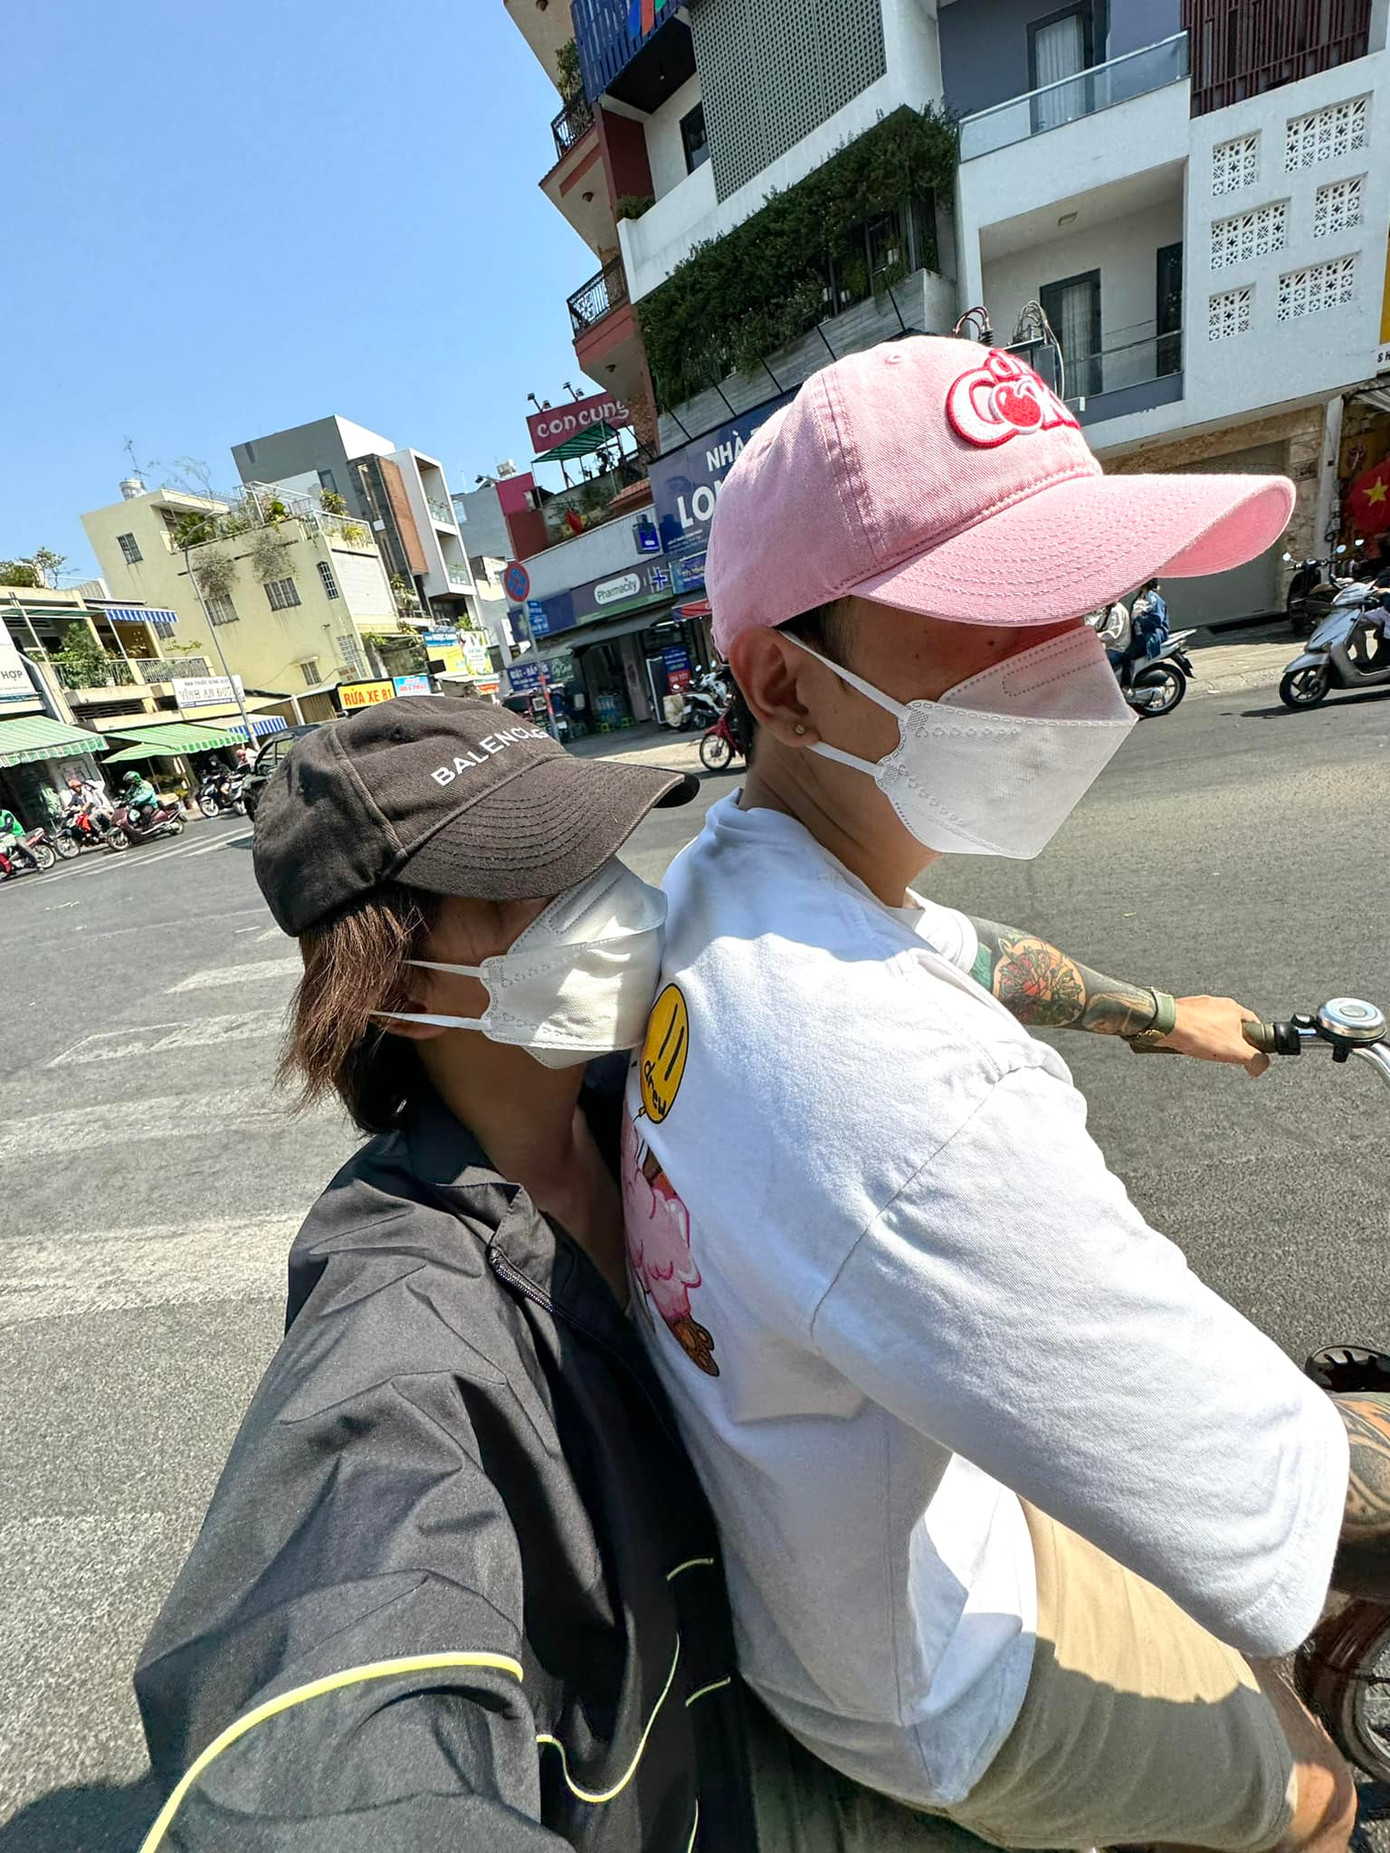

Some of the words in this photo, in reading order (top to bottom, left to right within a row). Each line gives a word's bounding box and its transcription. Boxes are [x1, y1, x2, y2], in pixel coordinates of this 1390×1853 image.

[677, 479, 723, 529] LO
[343, 687, 366, 706] RỬA
[366, 689, 380, 703] XE
[381, 688, 392, 701] 81
